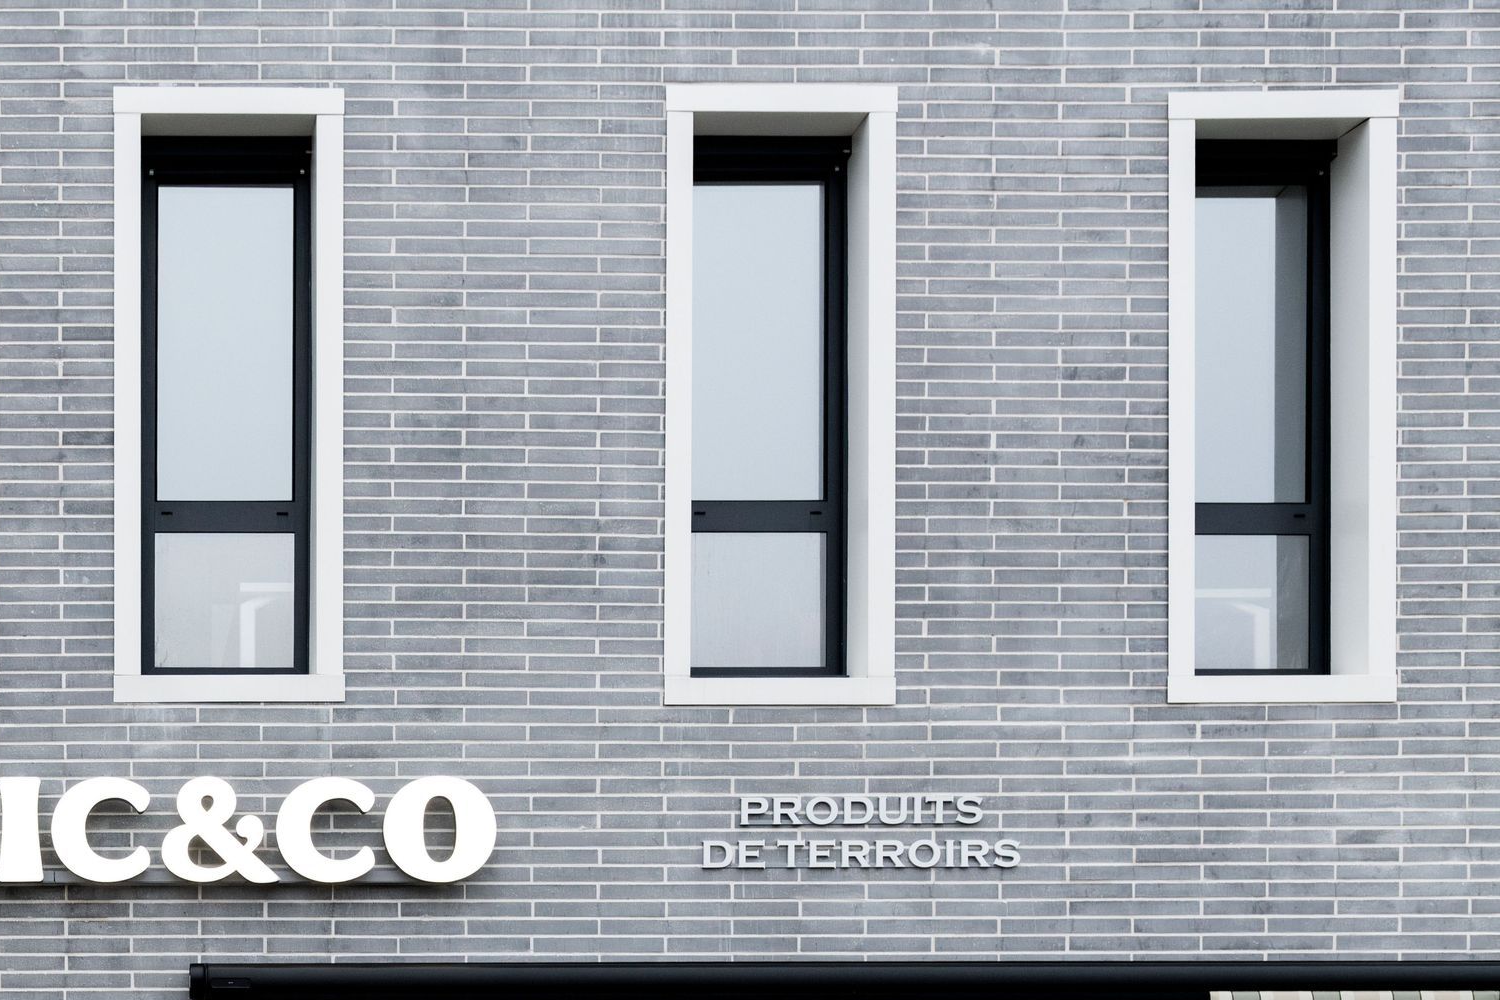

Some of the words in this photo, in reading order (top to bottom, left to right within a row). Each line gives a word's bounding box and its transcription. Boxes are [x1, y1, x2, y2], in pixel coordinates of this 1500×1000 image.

[739, 795, 984, 826] PRODUITS
[702, 839, 766, 869] DE
[776, 839, 1021, 869] TERROIRS
